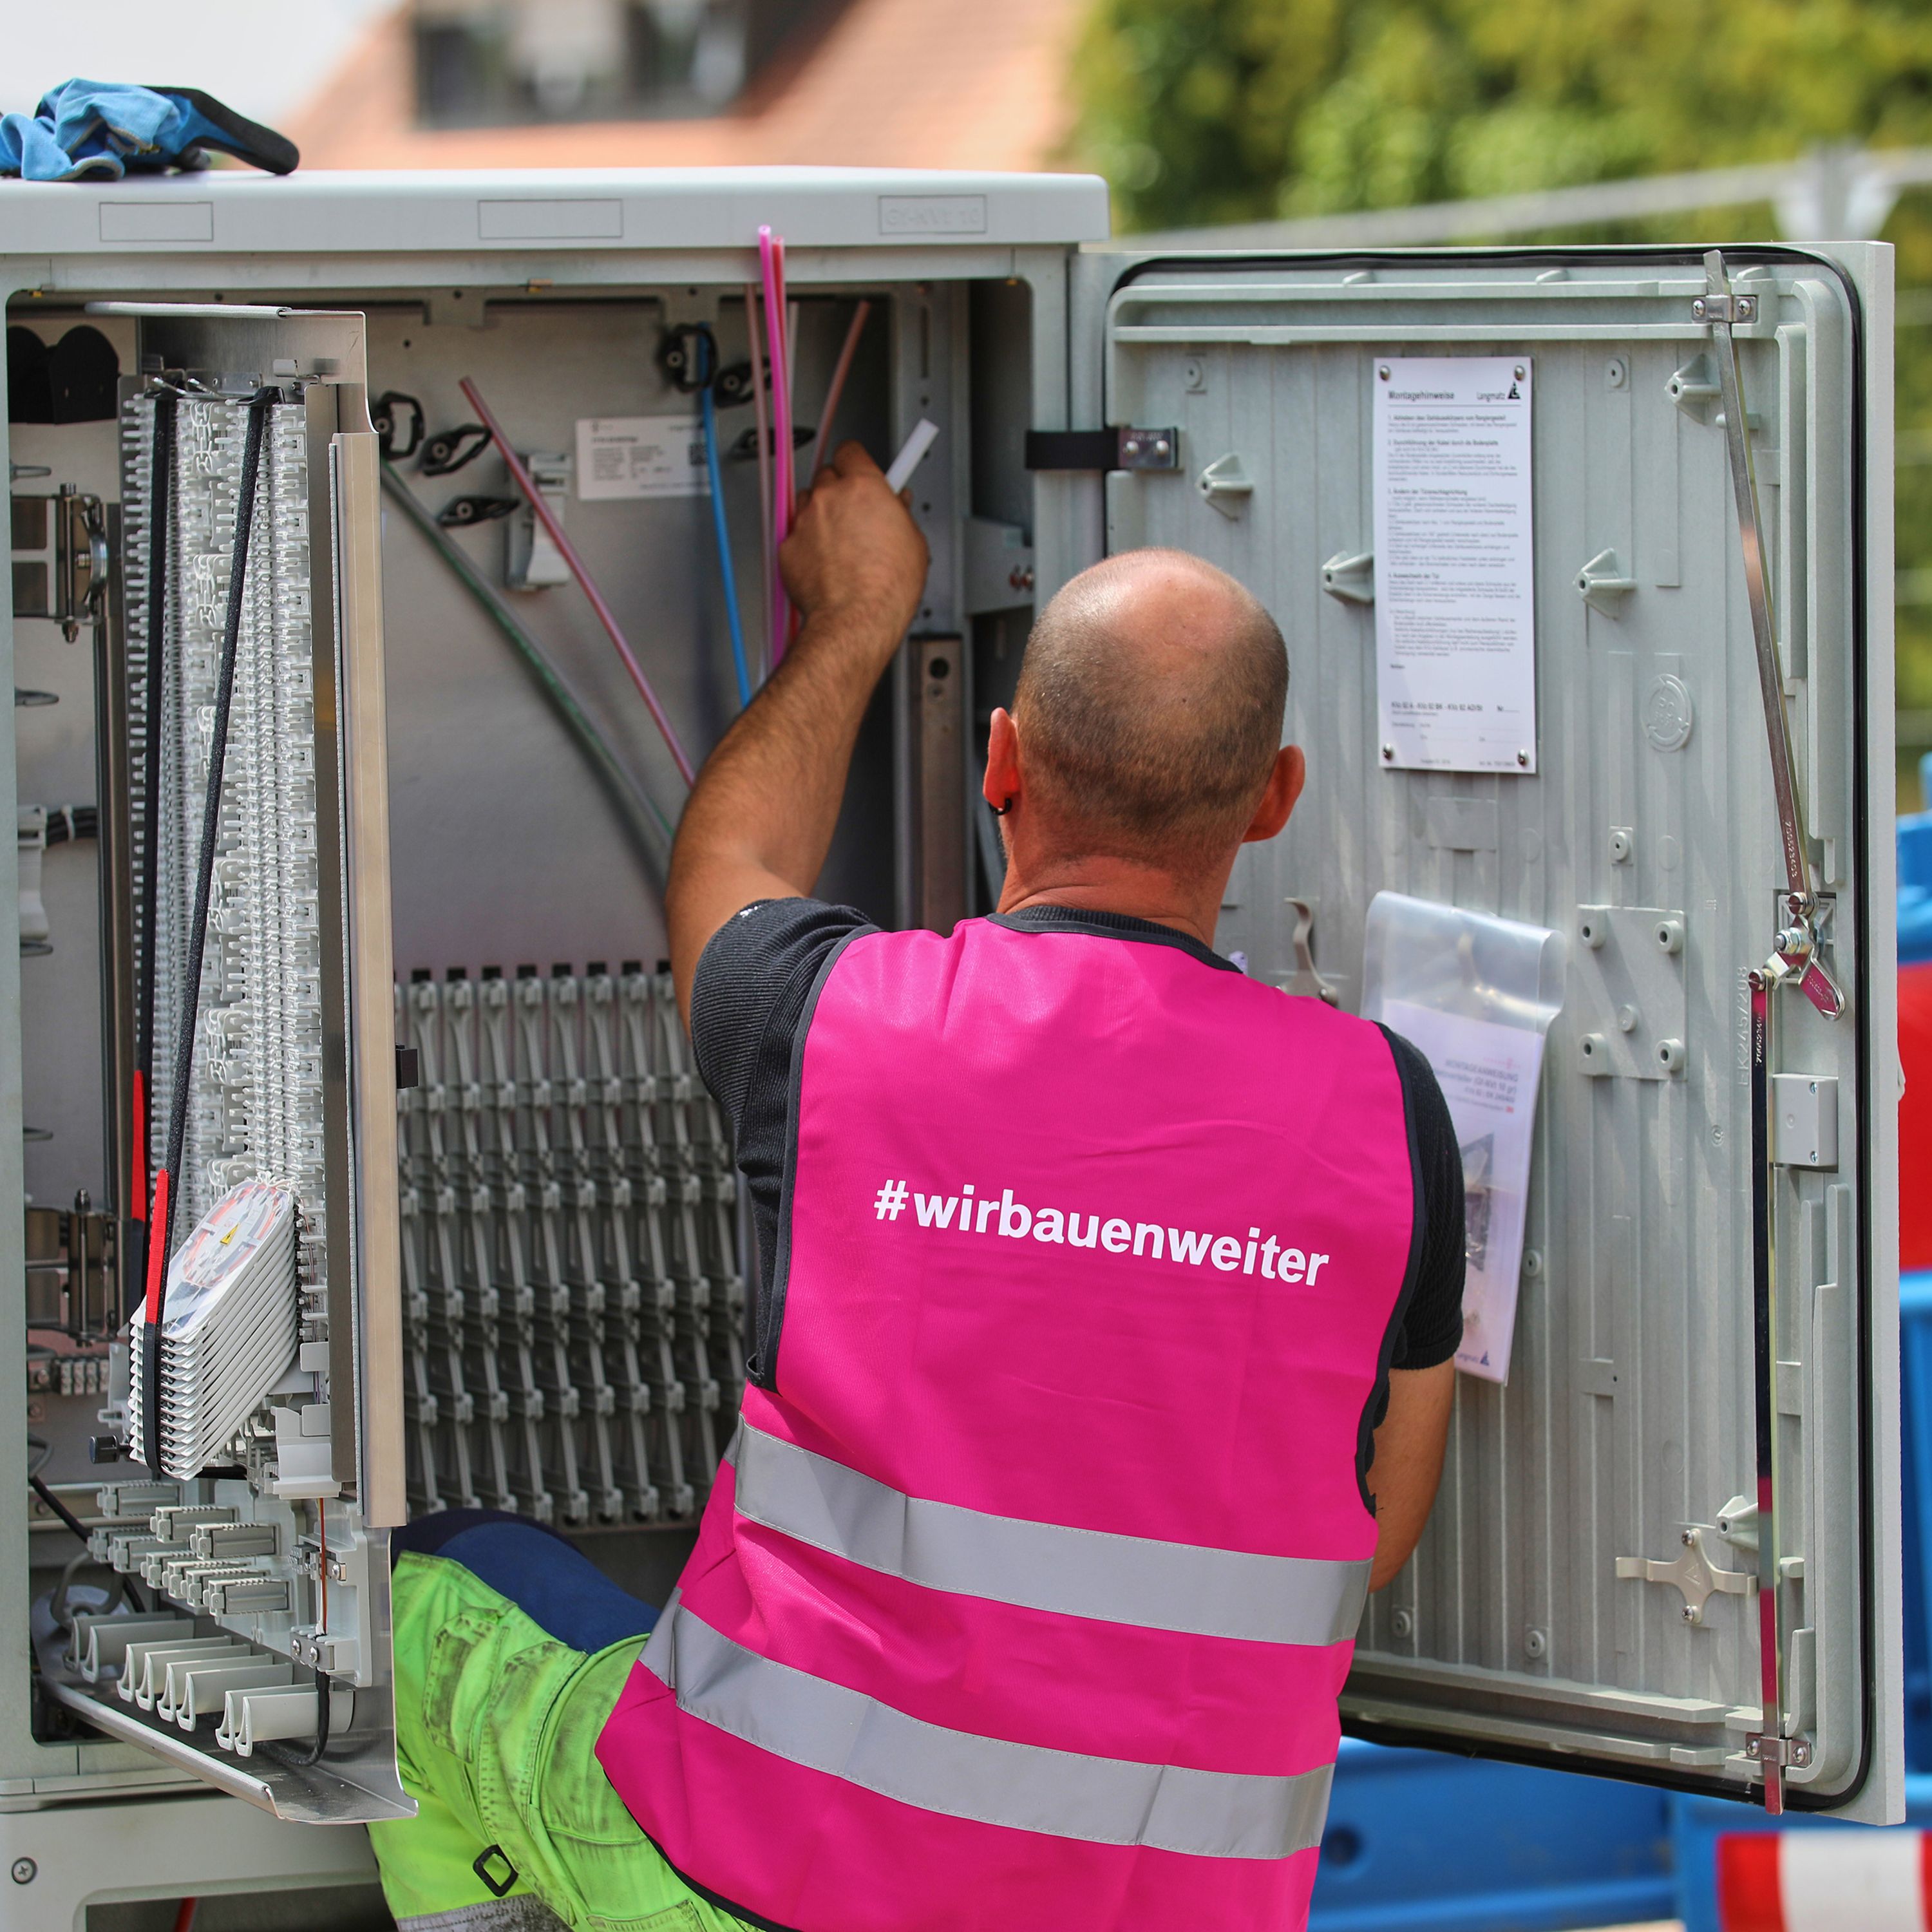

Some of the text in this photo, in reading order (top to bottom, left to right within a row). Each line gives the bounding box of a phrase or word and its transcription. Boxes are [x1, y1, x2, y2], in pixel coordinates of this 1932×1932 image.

[1388, 390, 1505, 402] Montagehinweise Langmatz
[1737, 966, 1749, 1086] EK245/208
[873, 1179, 1329, 1287] #wirbauenweiter
